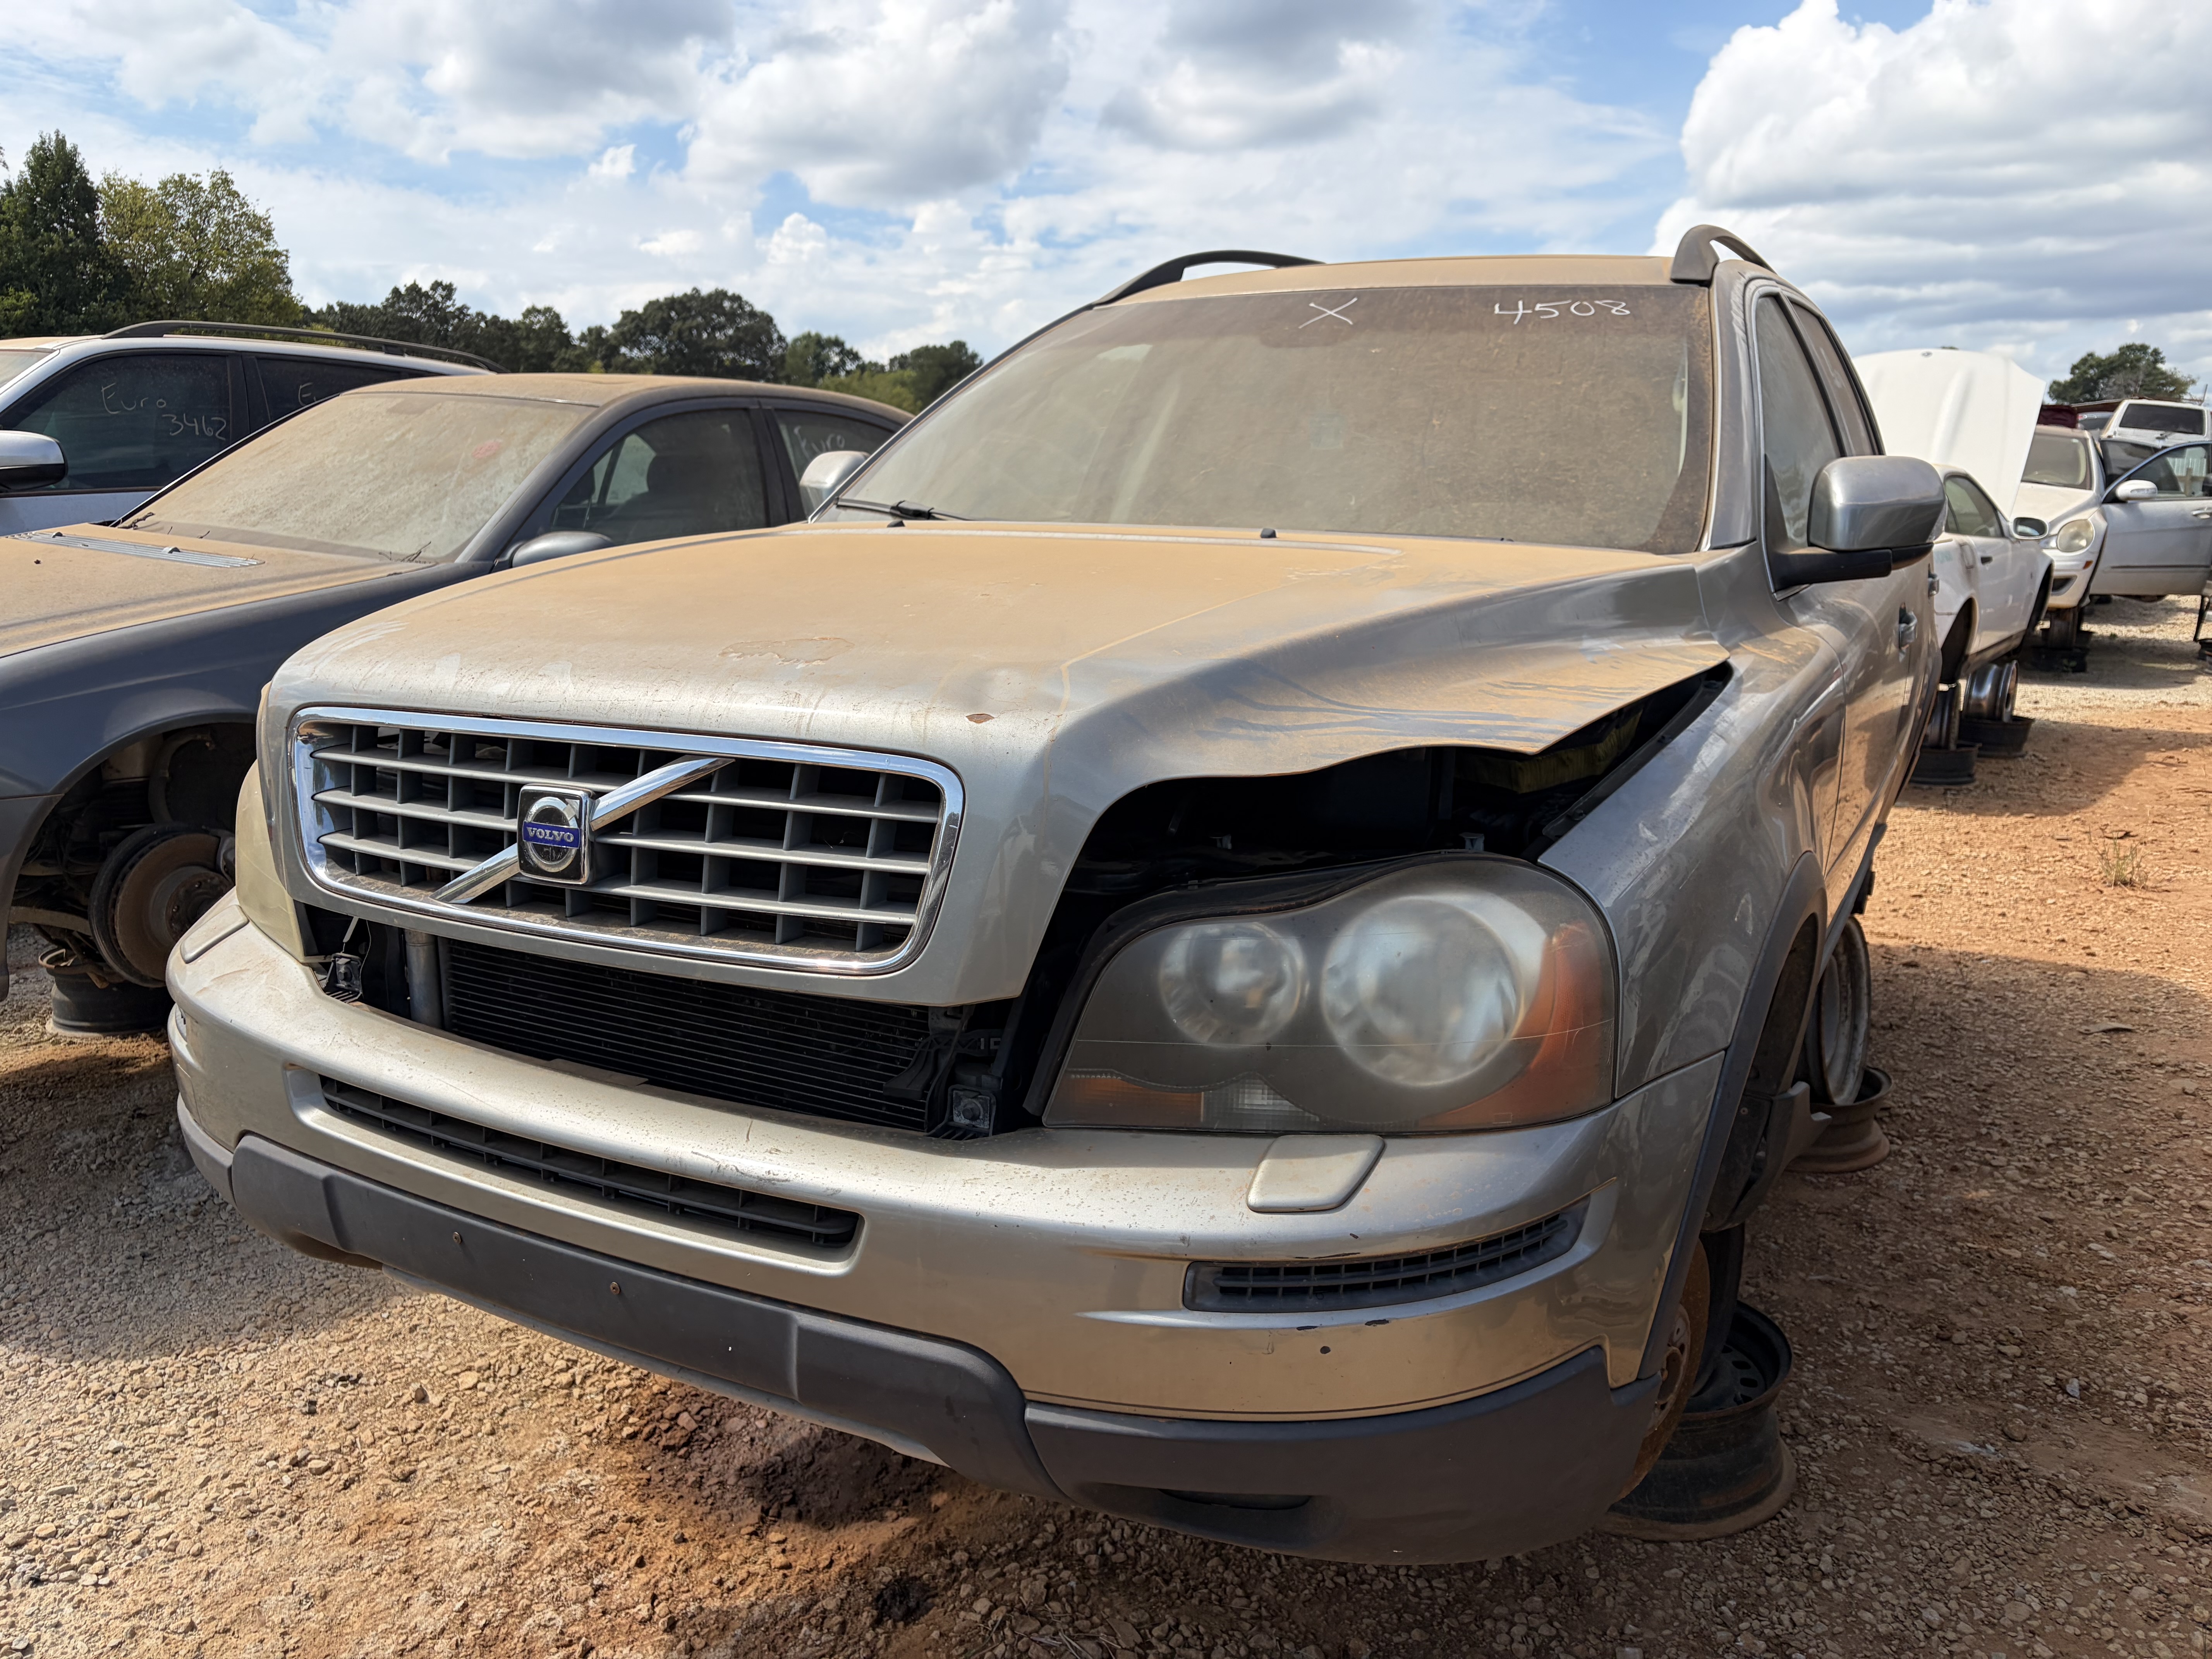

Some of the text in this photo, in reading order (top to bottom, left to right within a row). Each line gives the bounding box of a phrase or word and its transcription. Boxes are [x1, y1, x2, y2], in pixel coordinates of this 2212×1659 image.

[1494, 299, 1631, 325] 4508
[101, 383, 167, 414] Euro
[162, 413, 227, 441] 3462
[527, 827, 574, 842] VOLVO
